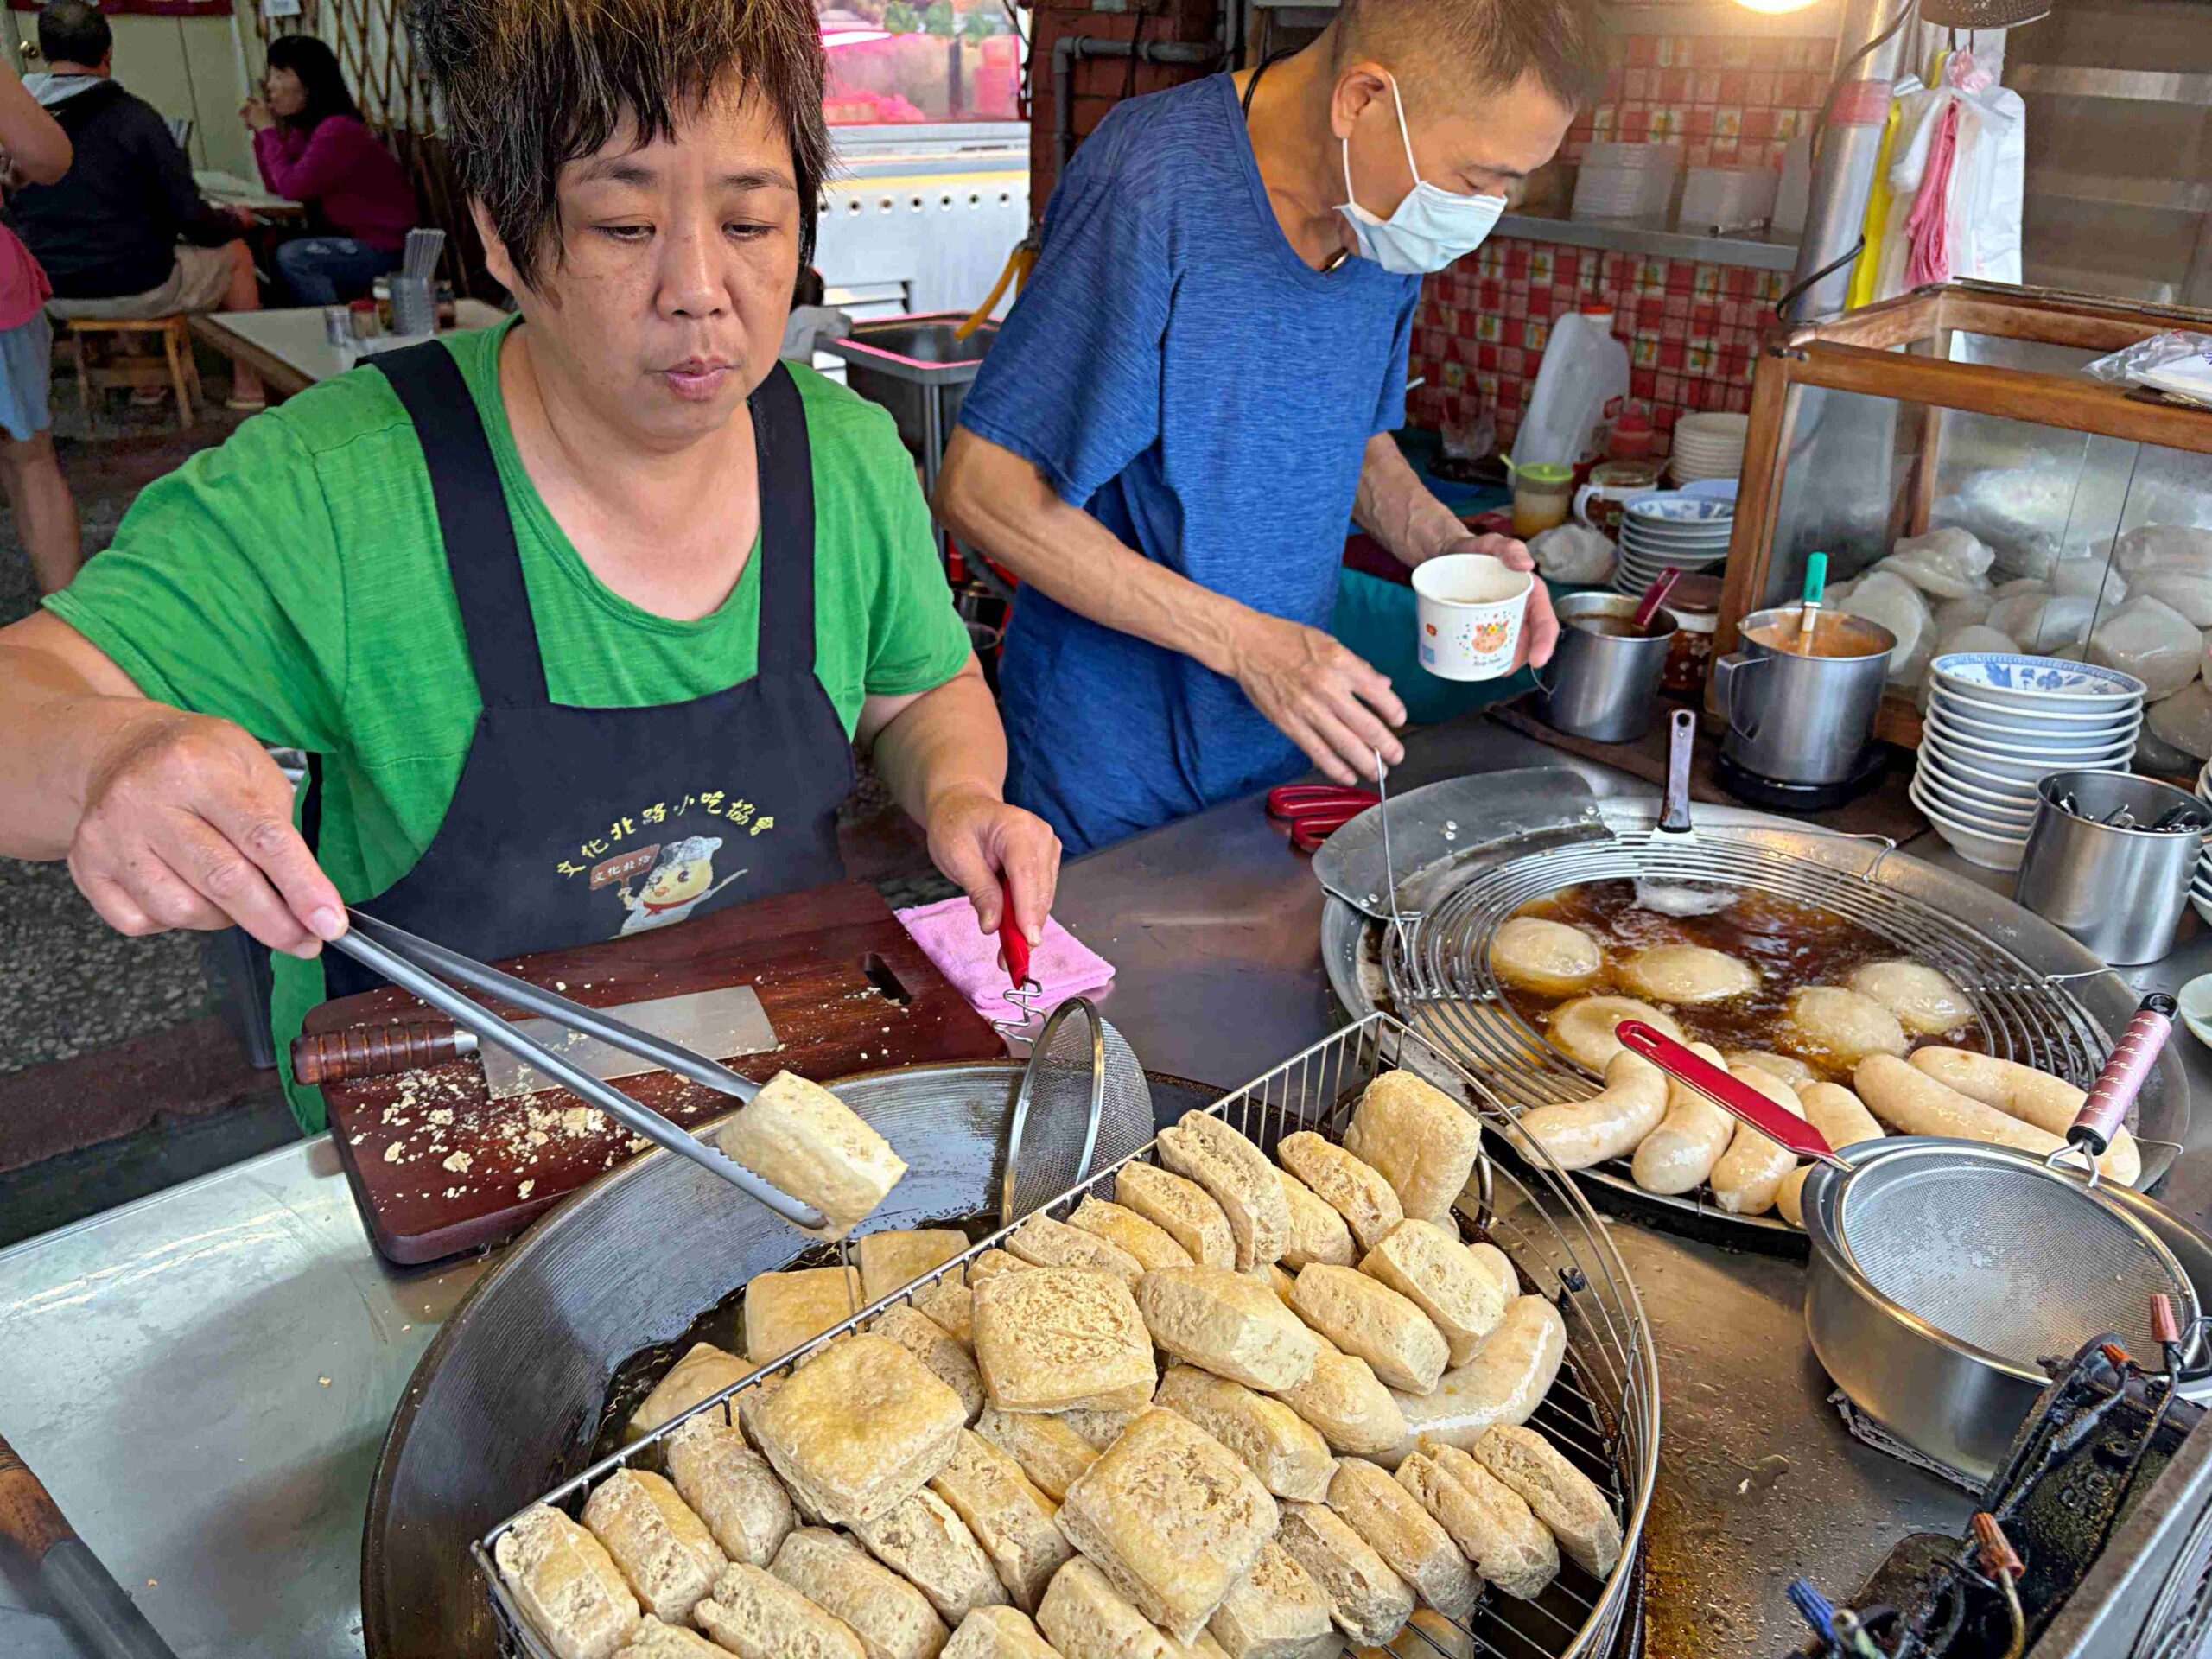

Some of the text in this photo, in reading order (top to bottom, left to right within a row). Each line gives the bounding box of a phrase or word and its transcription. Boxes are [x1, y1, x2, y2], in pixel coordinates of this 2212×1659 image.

[556, 791, 774, 880] 文化北路小吃協會
